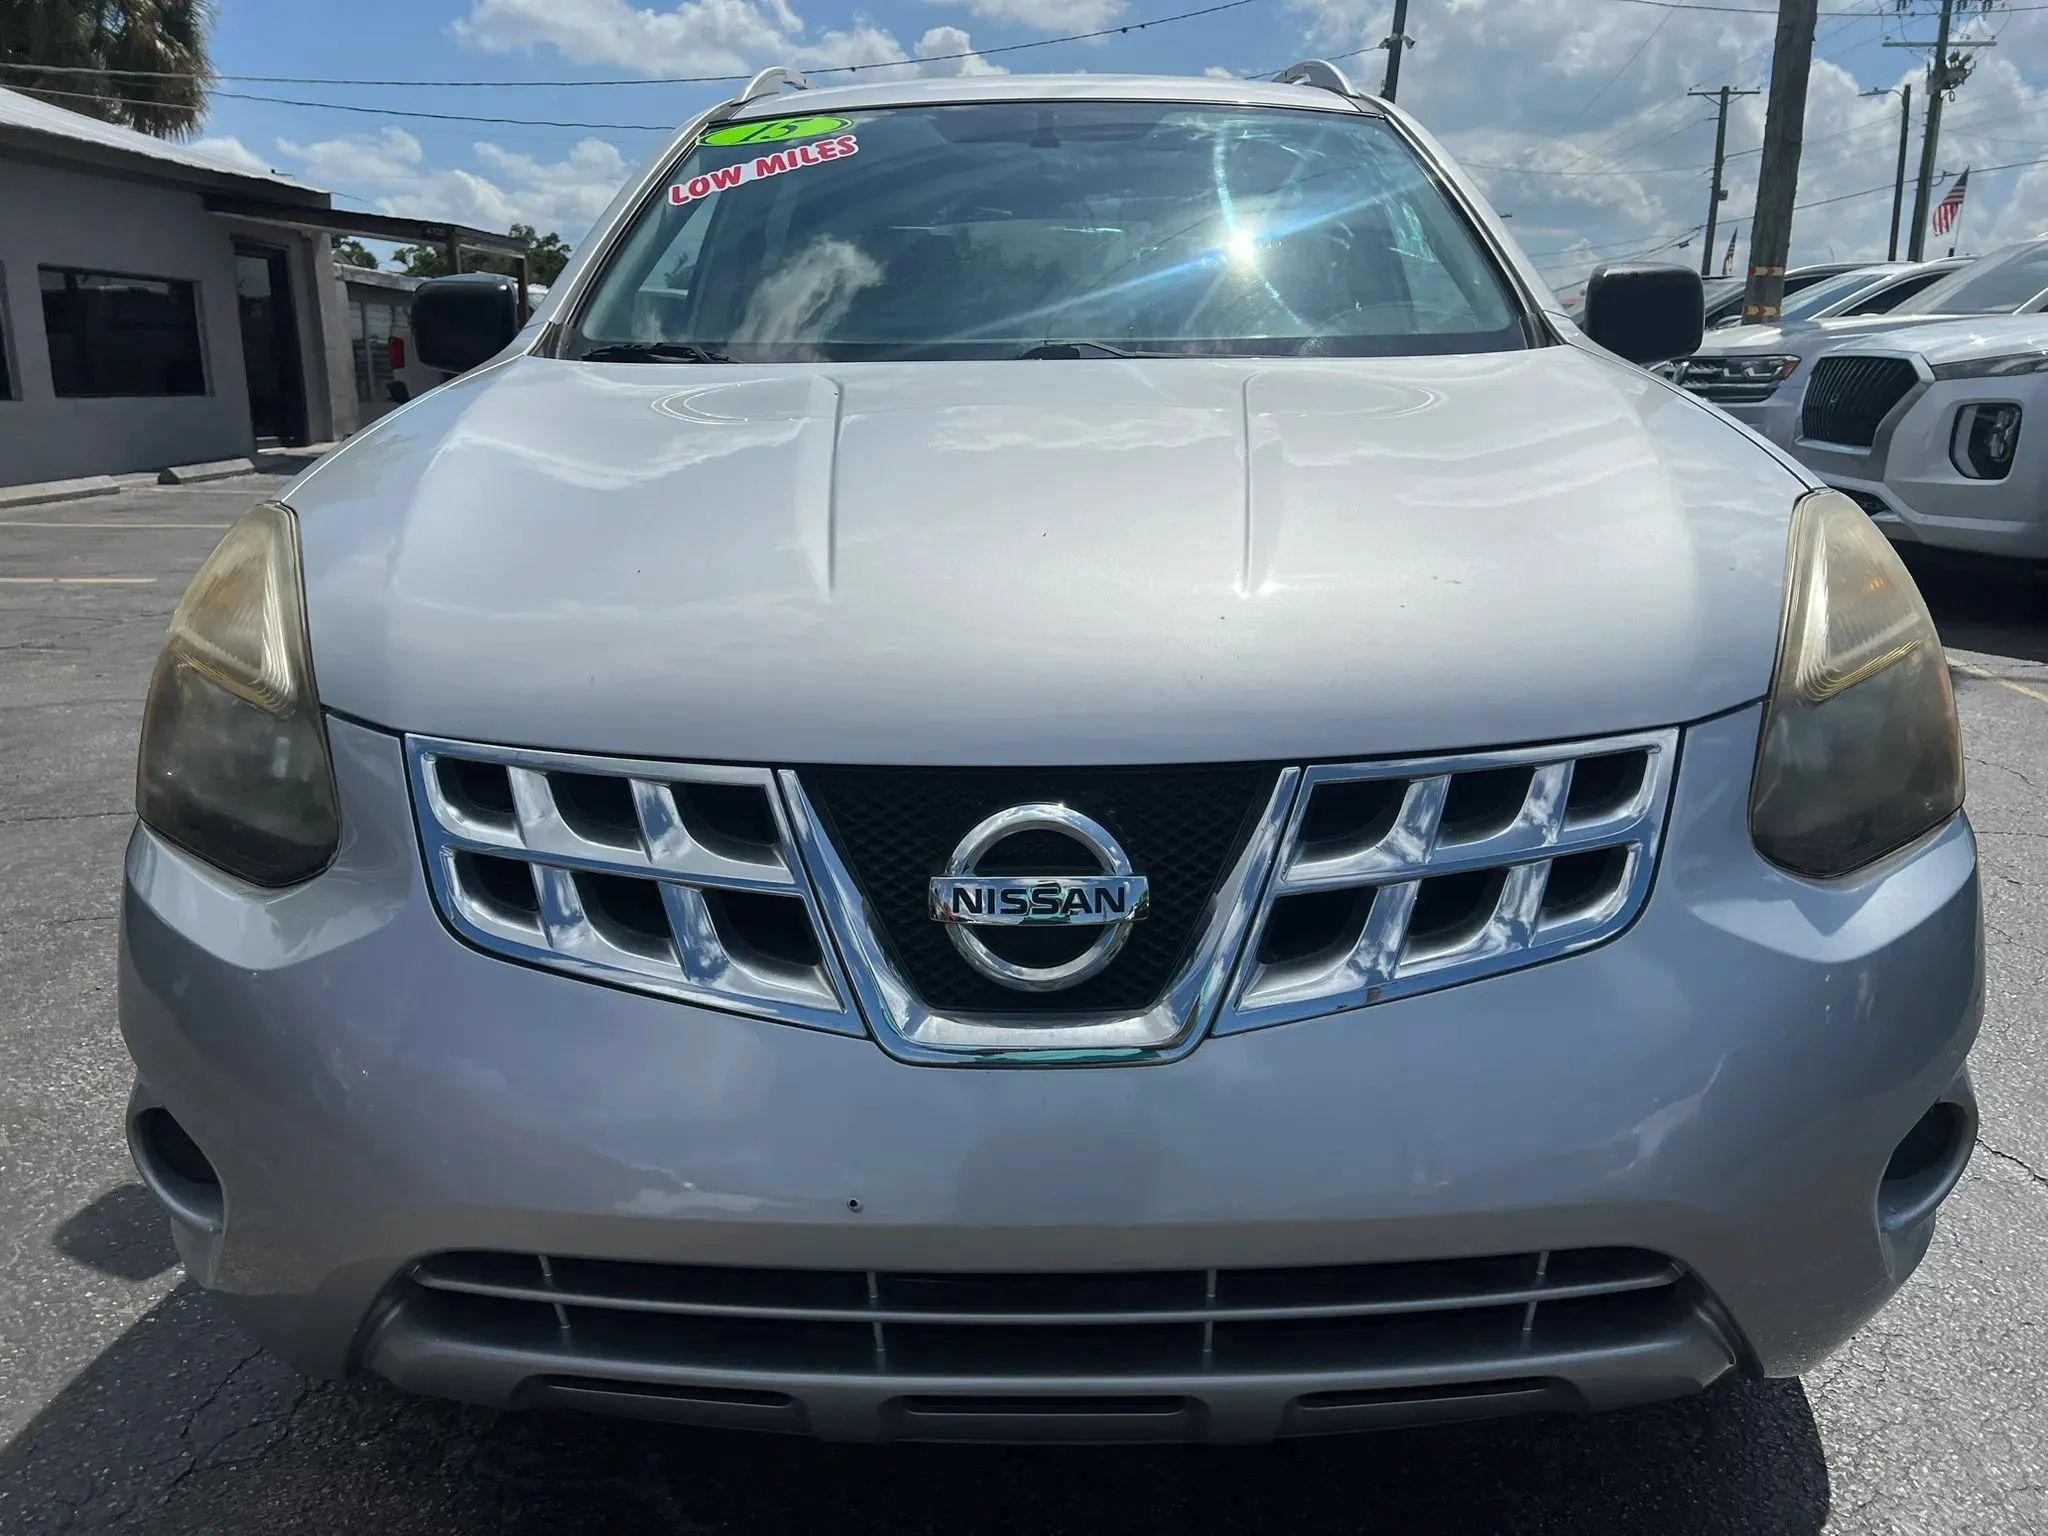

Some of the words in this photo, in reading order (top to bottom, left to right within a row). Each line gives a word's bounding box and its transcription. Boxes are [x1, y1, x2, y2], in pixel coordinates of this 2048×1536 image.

[739, 119, 811, 142] 15
[671, 165, 742, 204] LOW
[755, 136, 857, 177] MILES
[952, 884, 1125, 915] NISSAN
